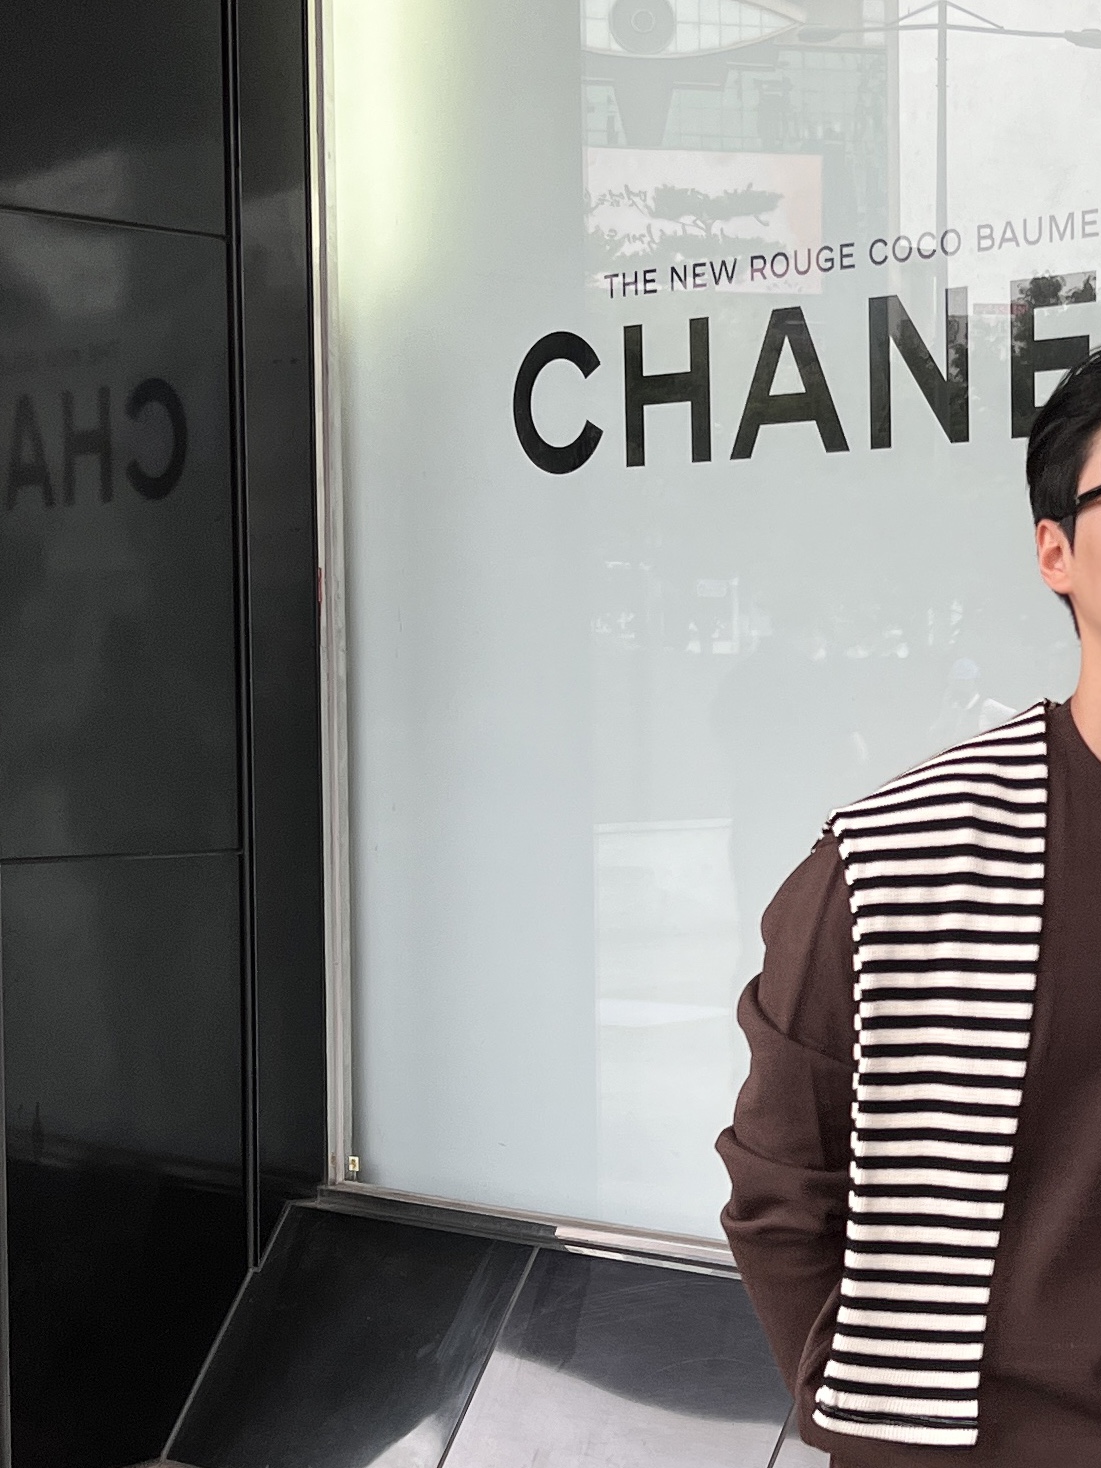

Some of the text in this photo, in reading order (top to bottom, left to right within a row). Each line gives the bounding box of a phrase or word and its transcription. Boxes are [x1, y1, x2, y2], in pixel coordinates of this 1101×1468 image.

[604, 208, 1100, 299] THE NEW ROUGE COCO BAUME
